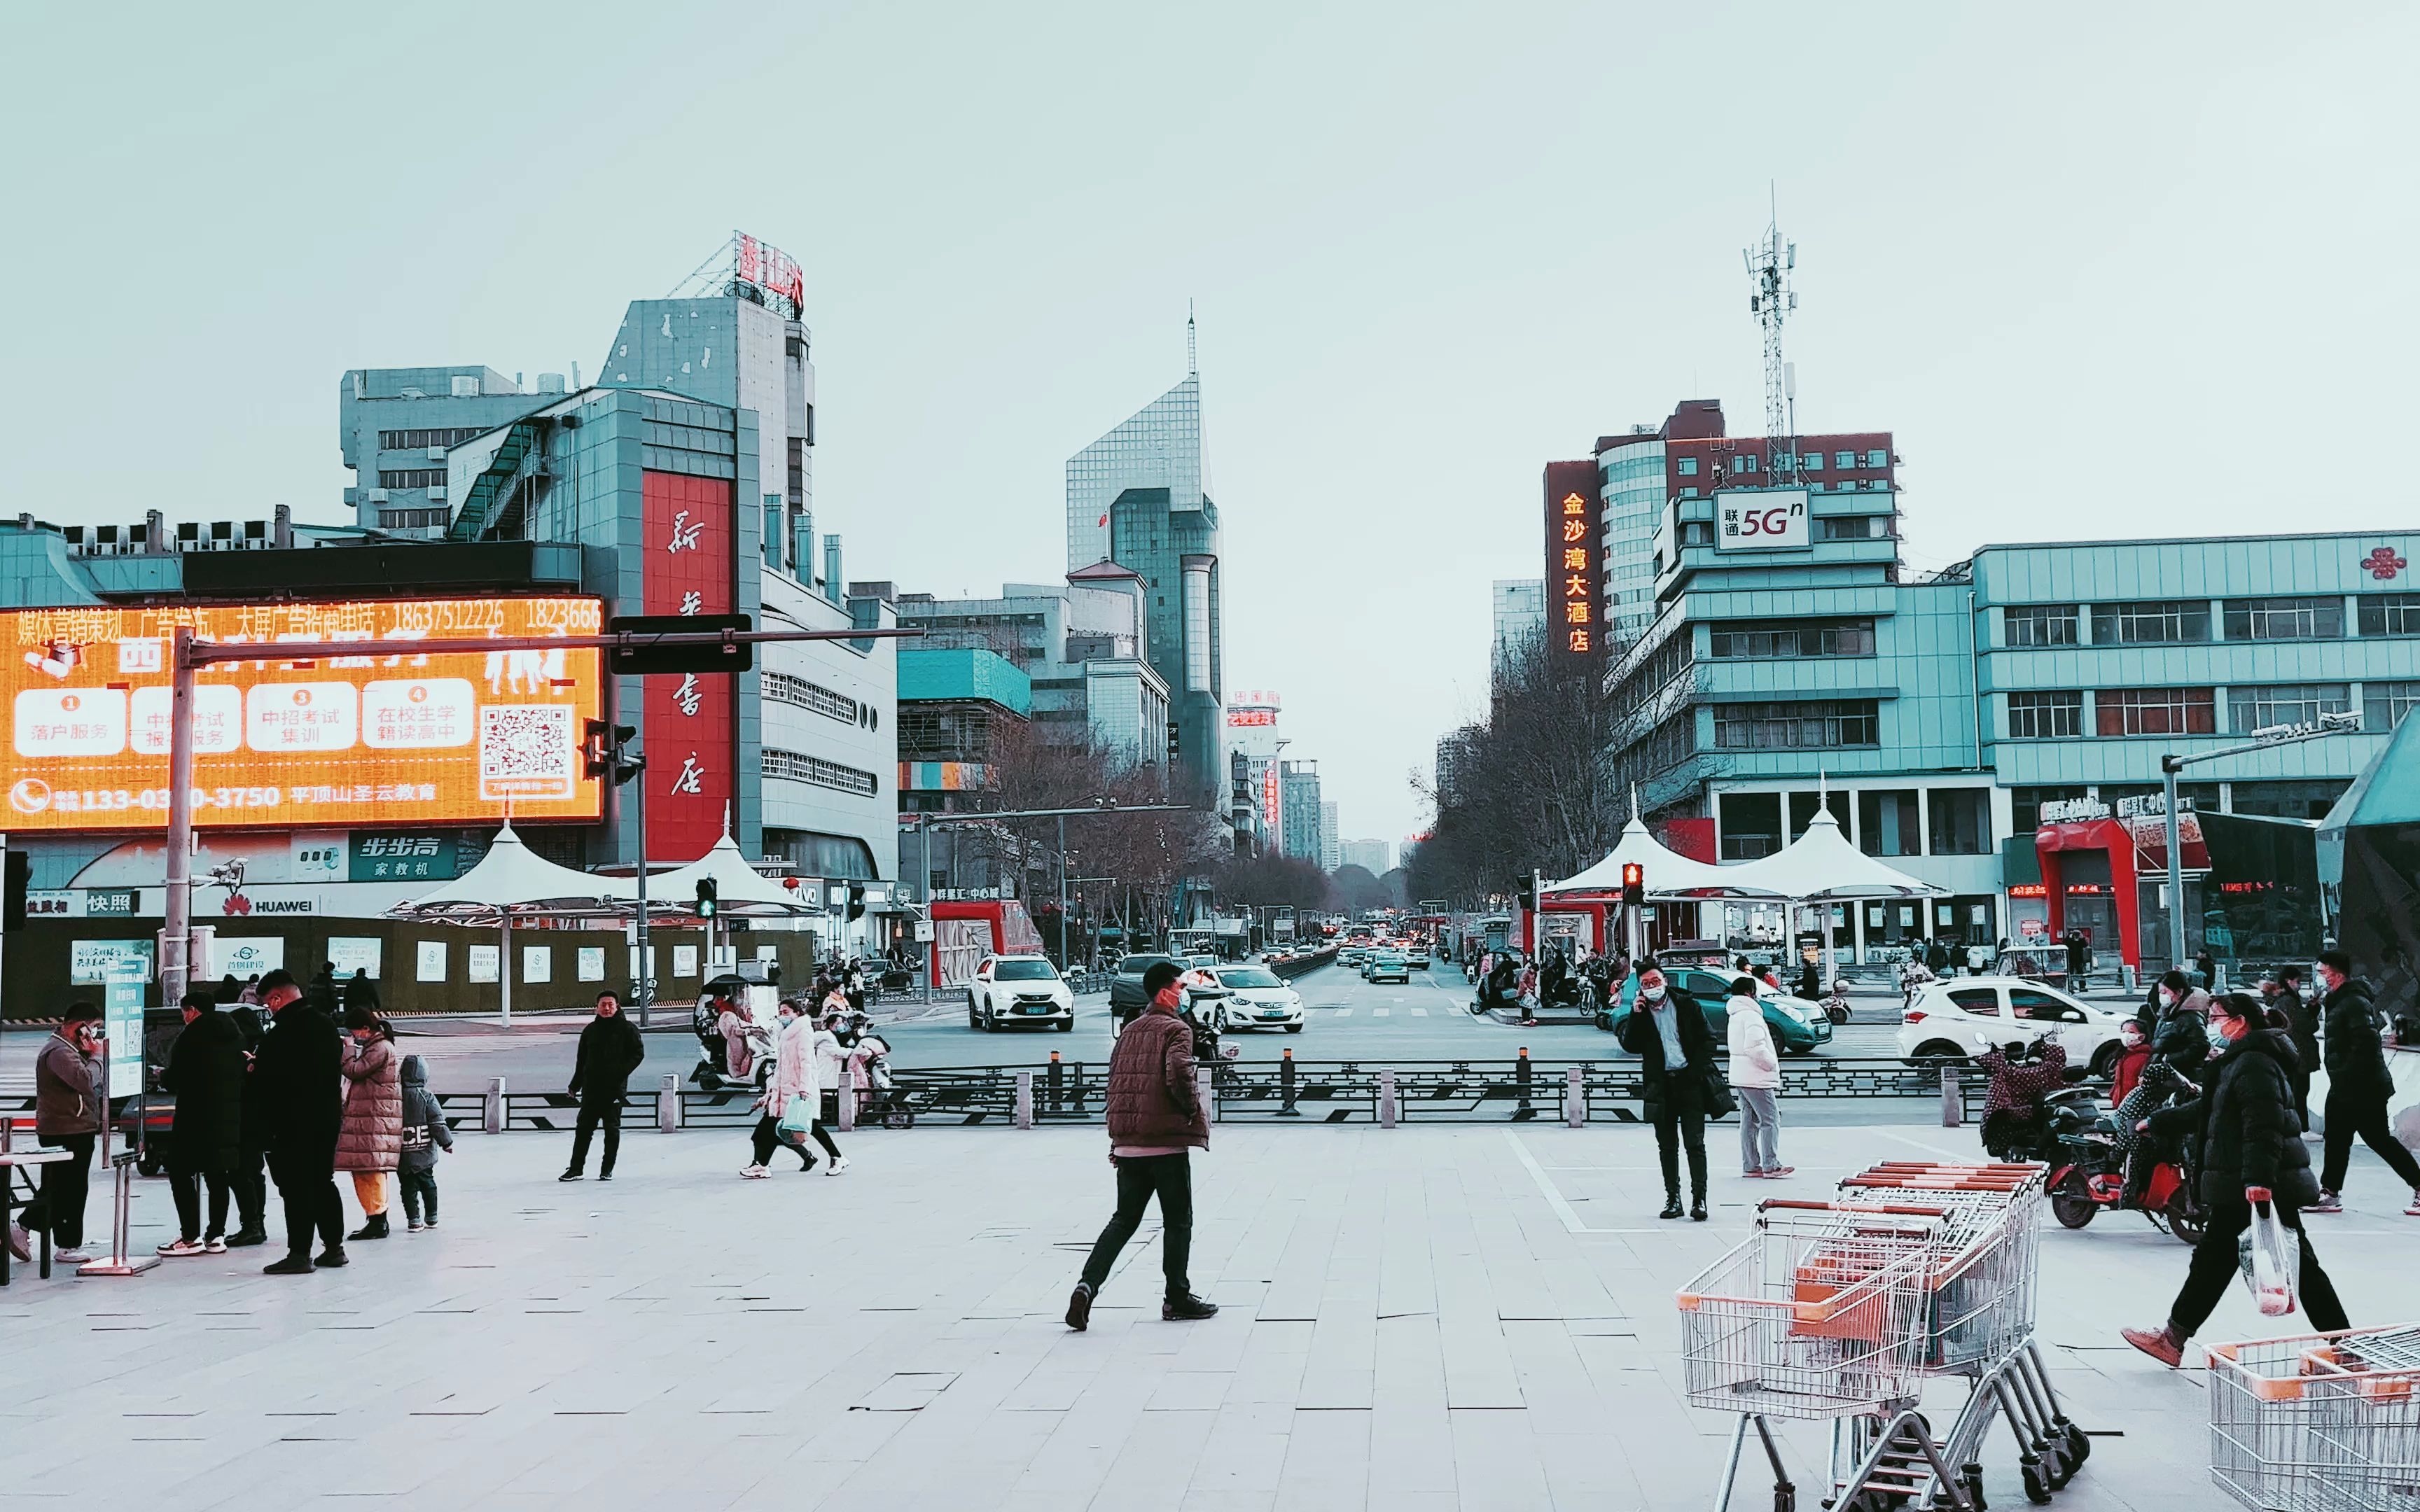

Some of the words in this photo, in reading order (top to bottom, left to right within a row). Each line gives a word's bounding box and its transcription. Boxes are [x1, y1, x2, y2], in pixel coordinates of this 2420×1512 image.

[1725, 509, 1739, 536] 联通
[1563, 491, 1589, 652] 金沙湾大酒店
[146, 711, 225, 729] 中考试
[262, 708, 340, 727] 中招考试
[377, 706, 456, 723] 在校生学
[31, 724, 109, 741] 落户服务
[146, 729, 225, 748] 报服务
[281, 726, 321, 744] 集训
[377, 724, 456, 742] 籍读高中
[82, 785, 280, 810] 133-030-3750
[291, 783, 437, 804] 平顶山圣云教育
[359, 837, 441, 857] 步步高
[373, 862, 429, 876] 家教机
[88, 894, 131, 912] 快照
[256, 900, 312, 913] HUAWEI
